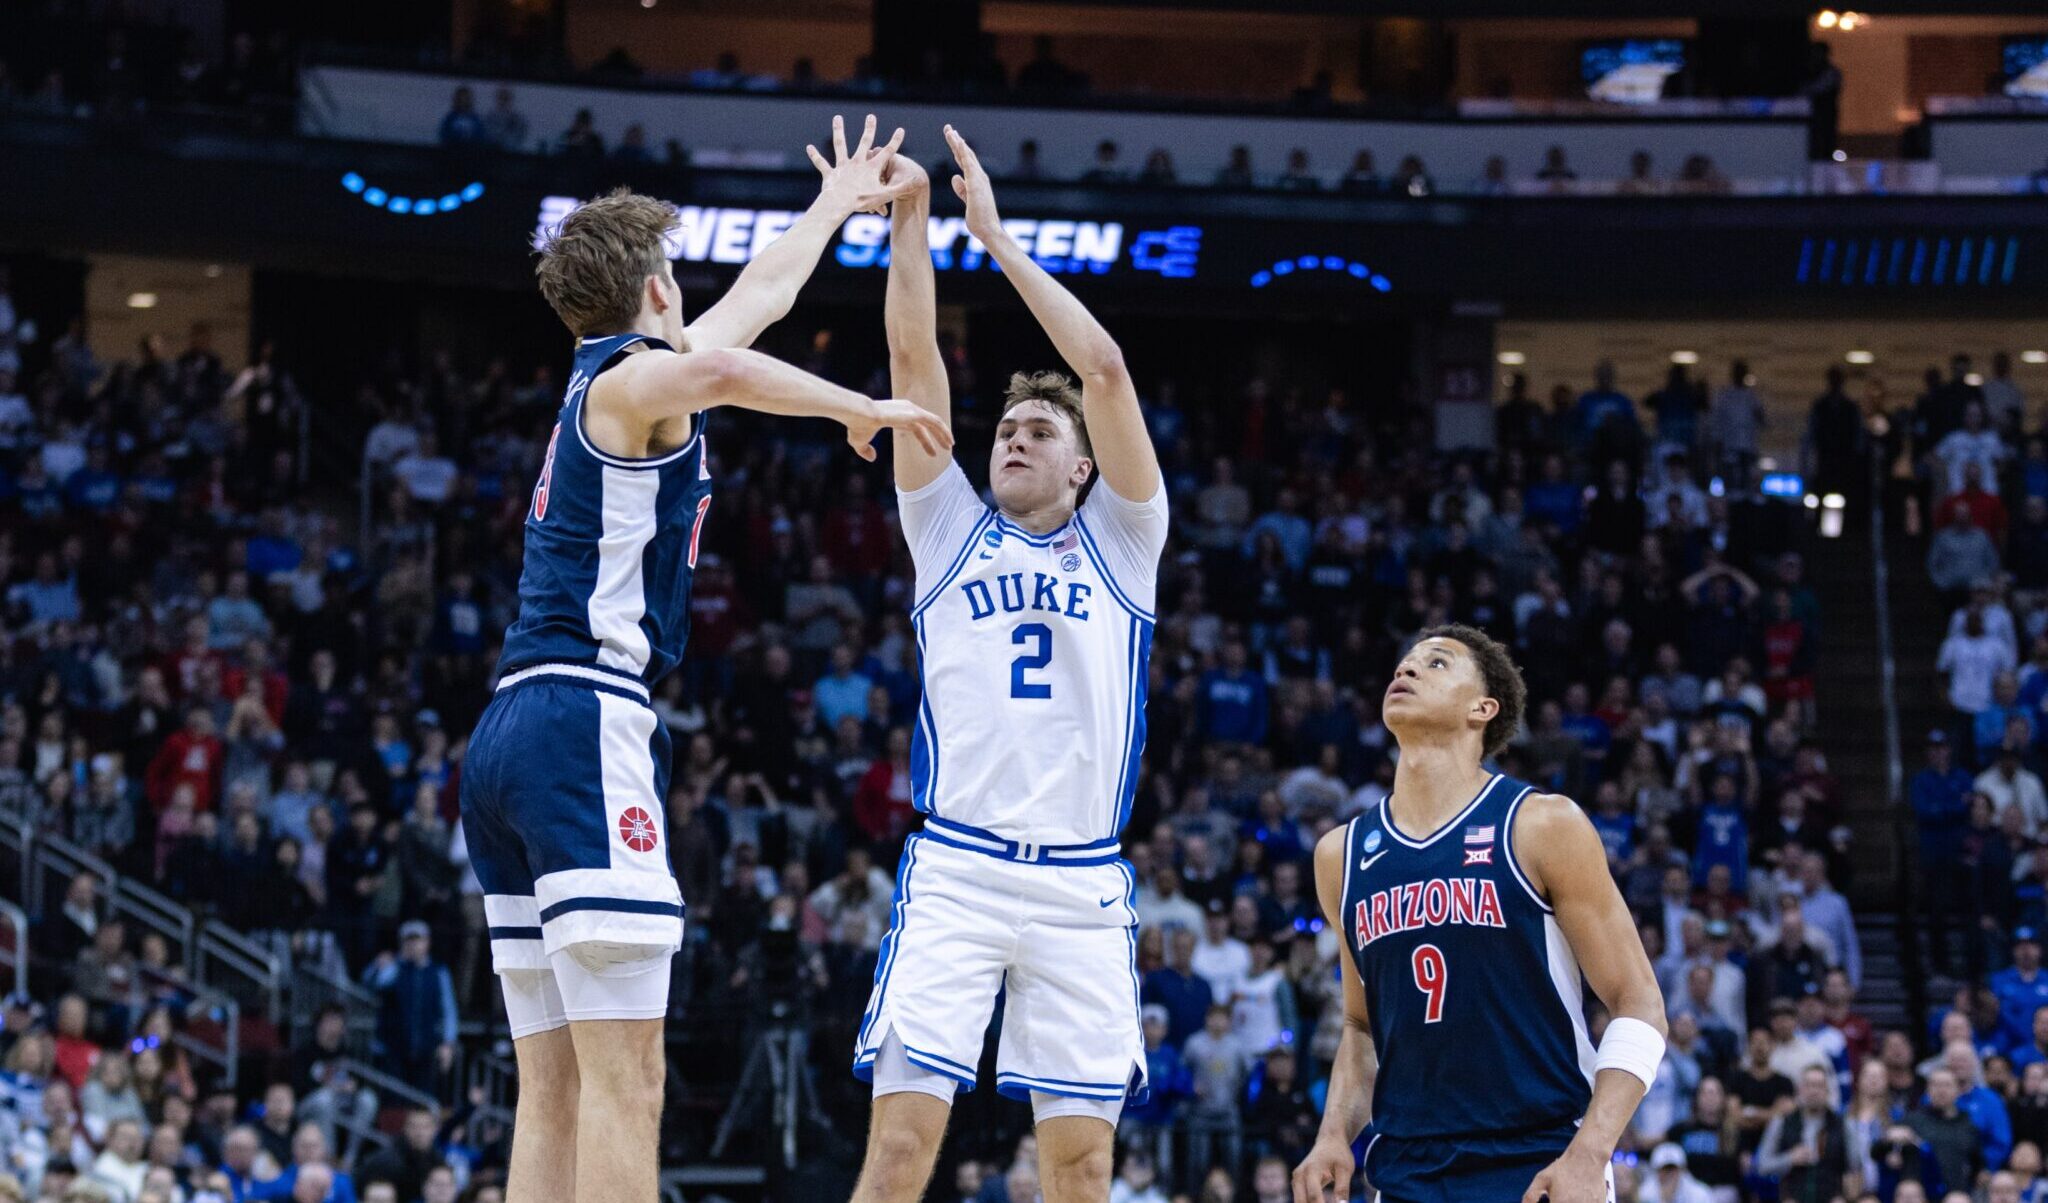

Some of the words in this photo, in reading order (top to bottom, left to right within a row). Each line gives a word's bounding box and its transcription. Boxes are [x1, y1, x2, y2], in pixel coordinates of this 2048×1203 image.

[960, 572, 1092, 621] DUKE
[1010, 623, 1052, 699] 2
[632, 820, 649, 838] A
[1355, 878, 1507, 951] ARIZONA
[1411, 944, 1447, 1024] 9
